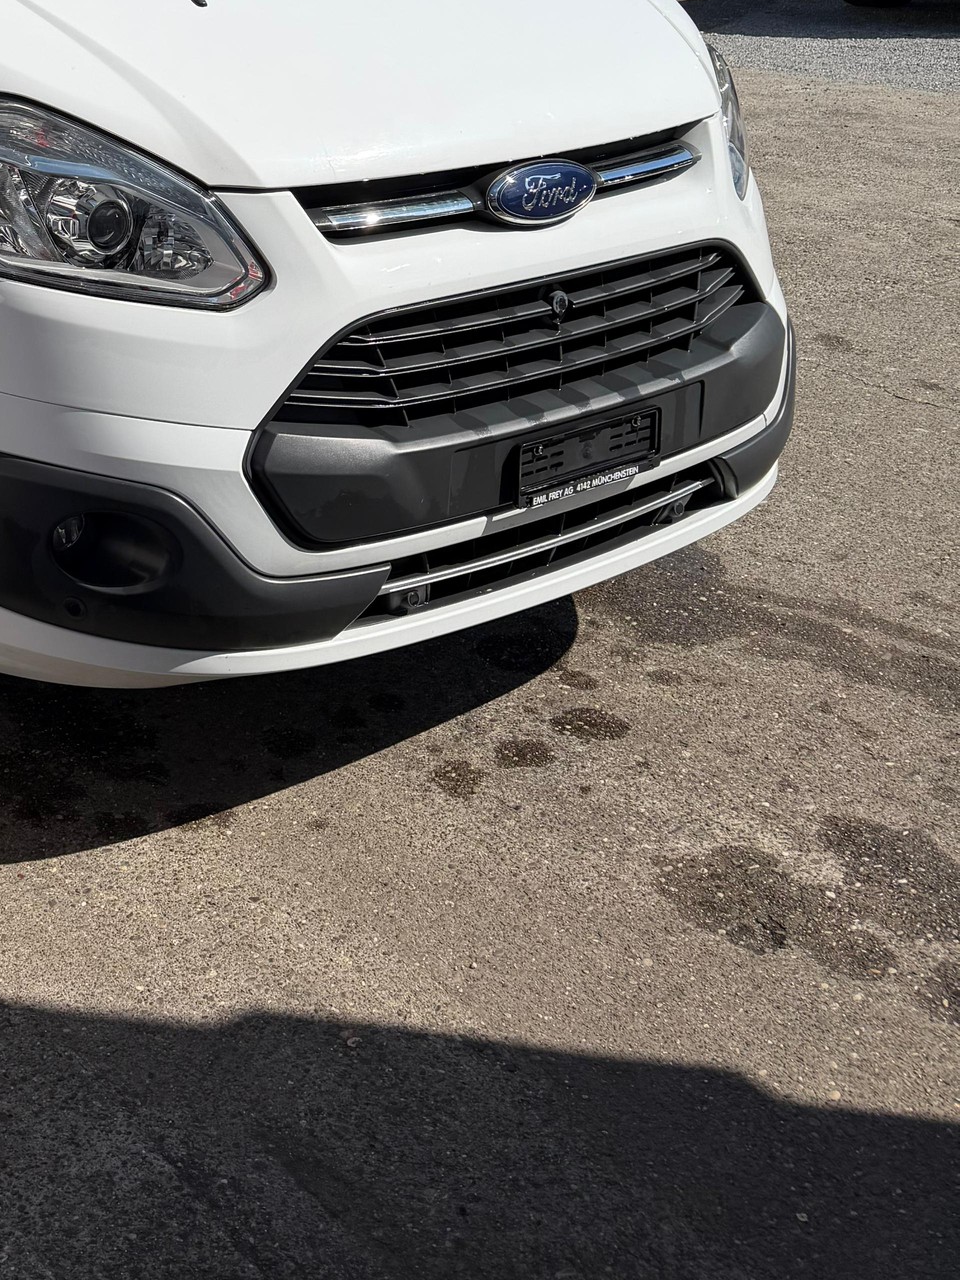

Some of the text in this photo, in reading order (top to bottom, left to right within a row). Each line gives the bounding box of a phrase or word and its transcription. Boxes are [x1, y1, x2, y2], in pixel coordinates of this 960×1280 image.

[522, 172, 578, 211] Ford
[533, 466, 639, 506] EMIL FREY AG 4142 MÜNCHENSTEIN
